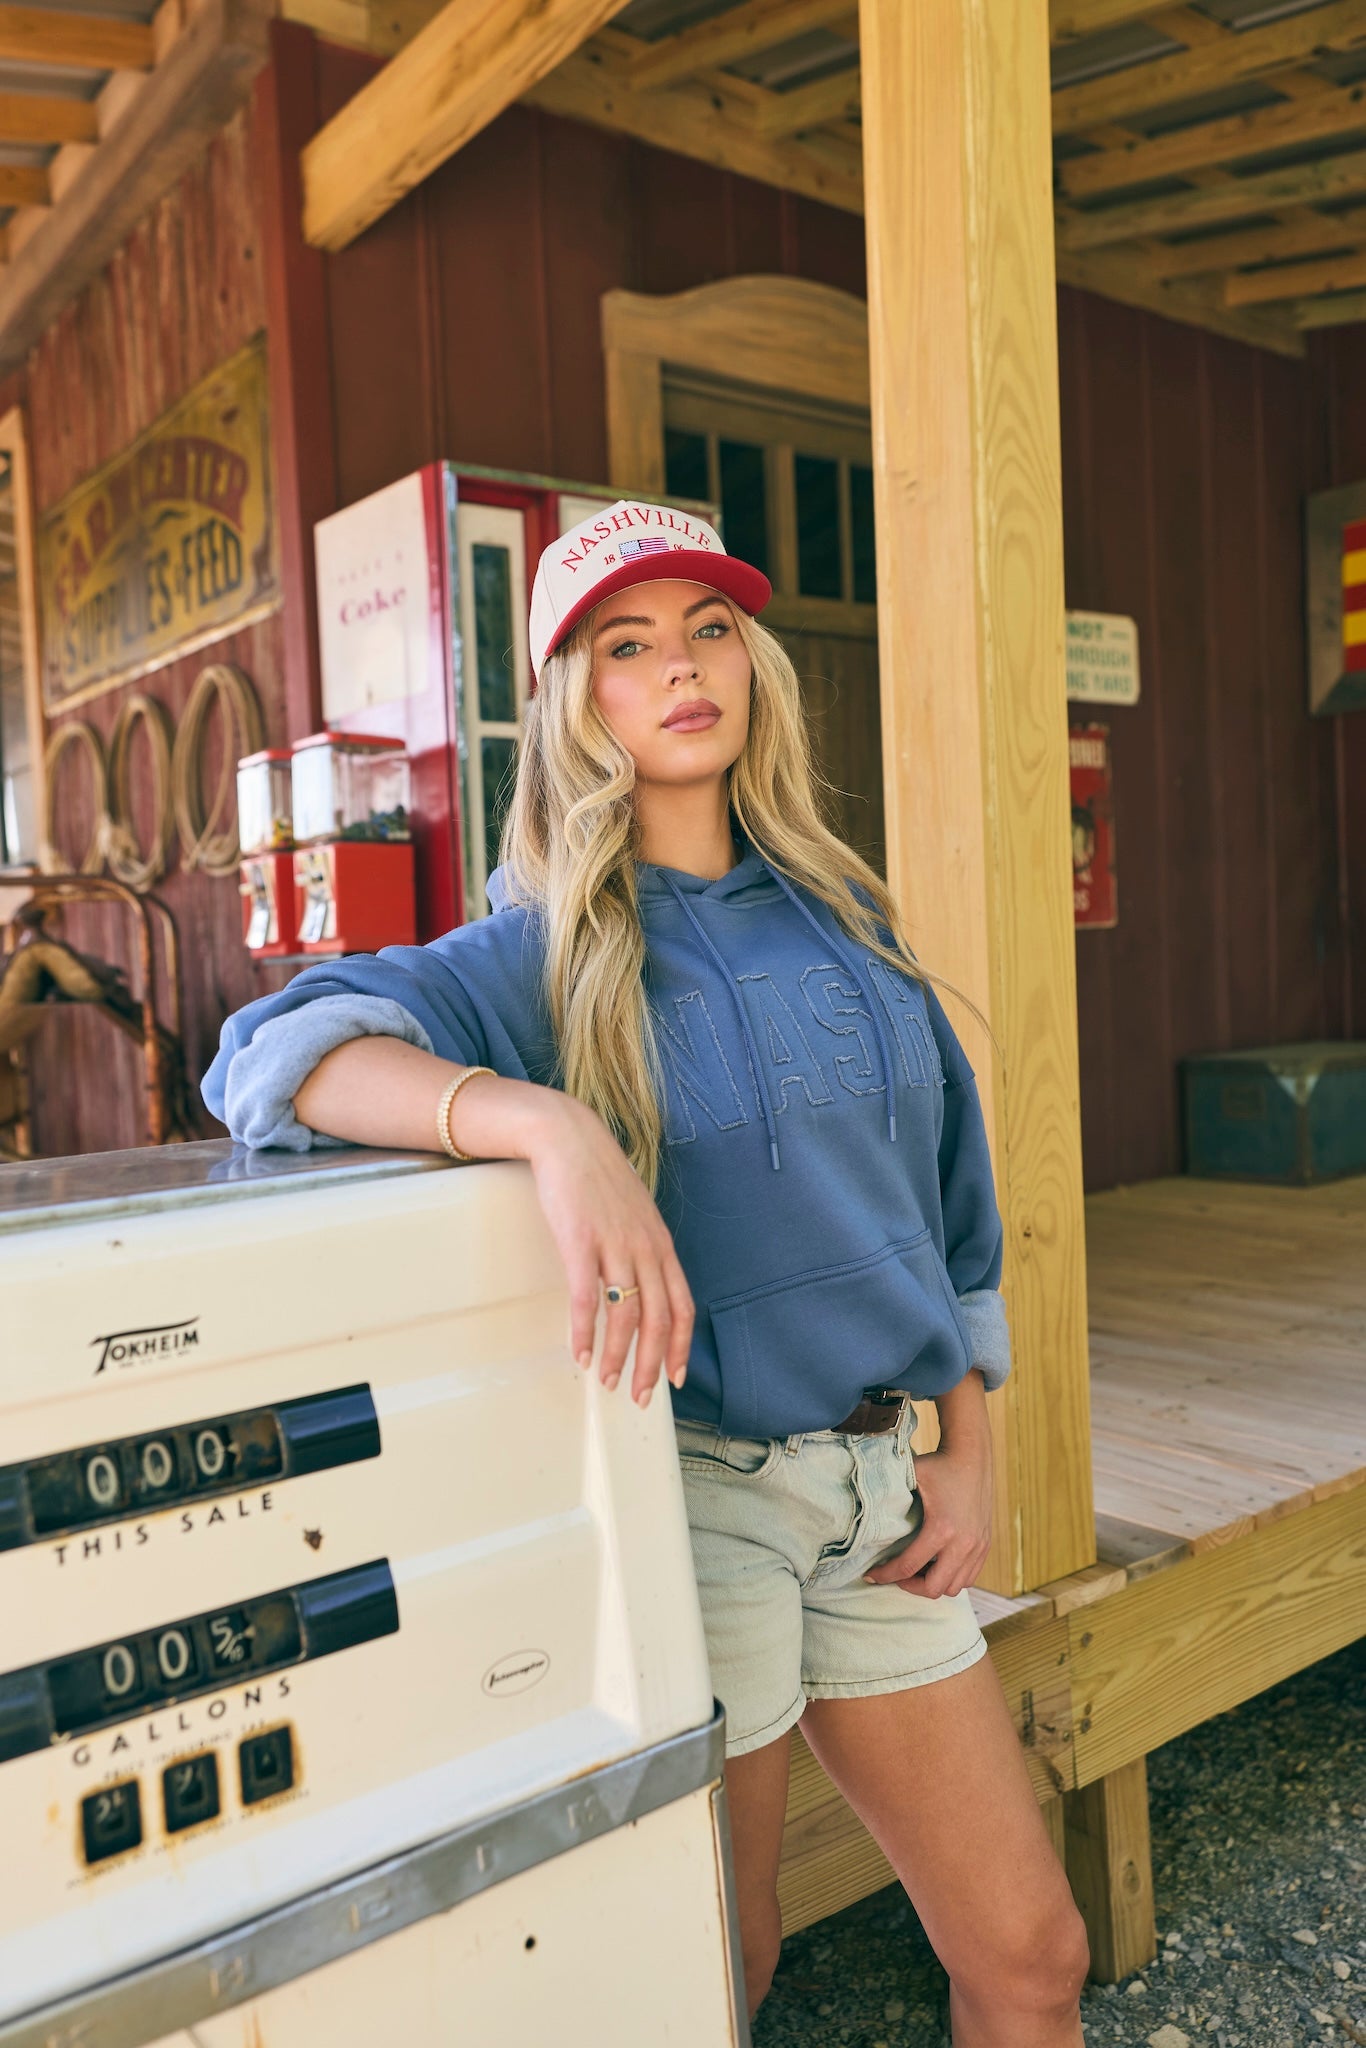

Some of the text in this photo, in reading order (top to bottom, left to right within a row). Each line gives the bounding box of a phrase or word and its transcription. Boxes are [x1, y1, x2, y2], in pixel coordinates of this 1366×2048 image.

[182, 516, 242, 614] FEED
[561, 507, 711, 573] NASHVILLE
[603, 553, 616, 565] 18
[339, 587, 406, 626] Coke
[1066, 645, 1130, 668] HROUGH
[650, 958, 946, 1145] NASH
[88, 1315, 199, 1375] TOKHEIM
[54, 1491, 275, 1567] THIS SALE
[73, 1676, 292, 1767] GALLONS
